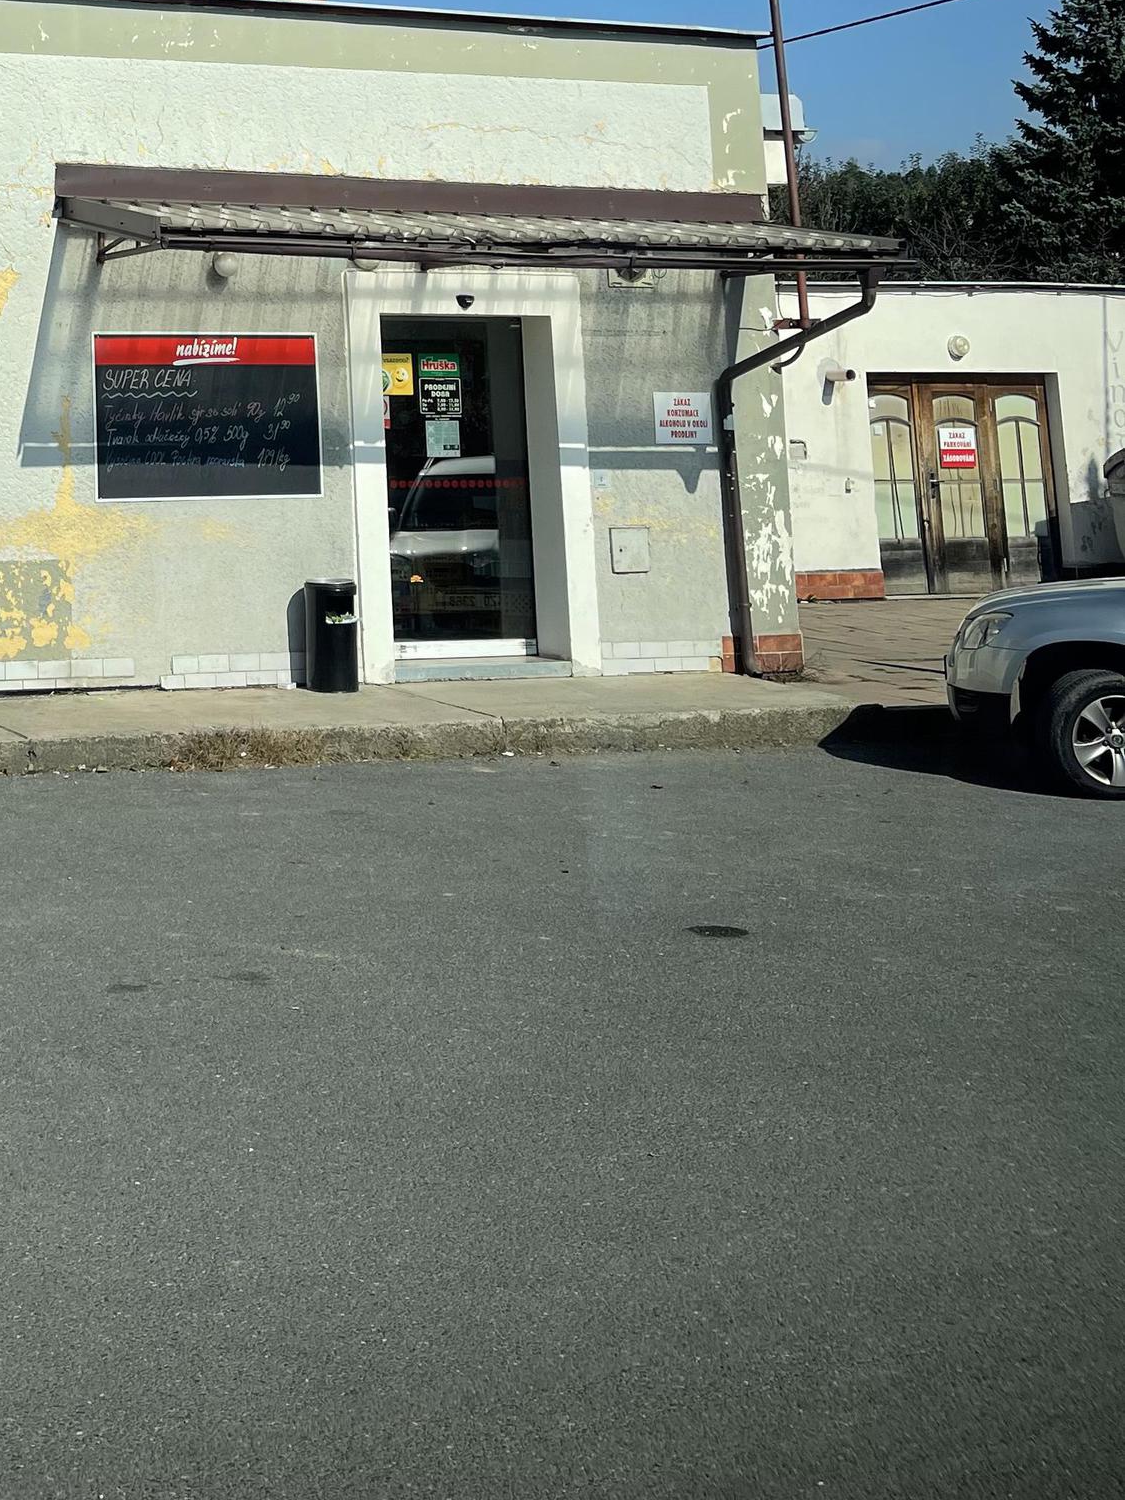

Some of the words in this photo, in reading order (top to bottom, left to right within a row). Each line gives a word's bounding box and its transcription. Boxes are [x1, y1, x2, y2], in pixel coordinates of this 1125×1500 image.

[176, 337, 237, 357] nabízíme!
[422, 360, 456, 370] Hruška
[103, 368, 149, 390] SUPER
[154, 368, 192, 389] CENA
